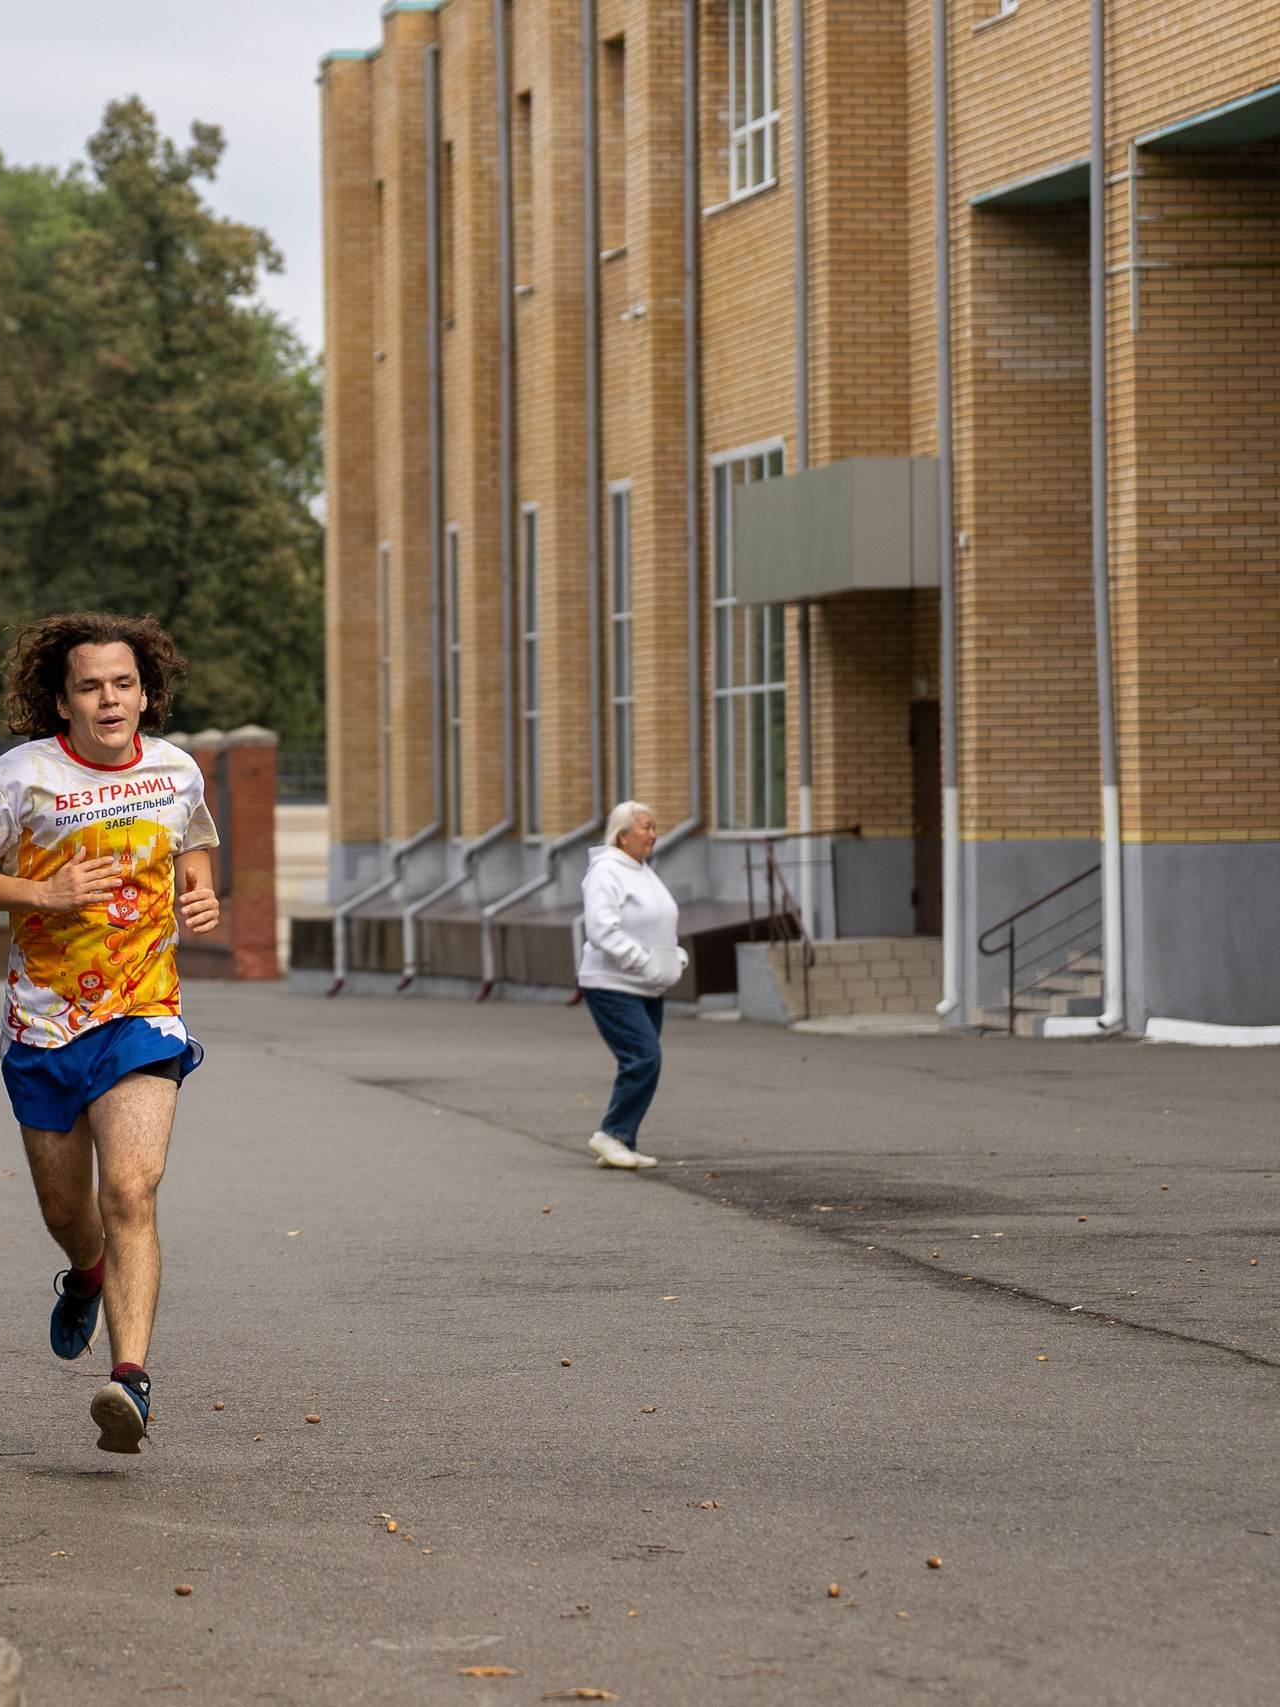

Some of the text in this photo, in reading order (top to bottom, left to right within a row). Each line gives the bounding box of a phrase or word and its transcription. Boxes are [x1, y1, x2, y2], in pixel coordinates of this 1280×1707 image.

[55, 776, 176, 811] БЕЗ ГРАНИЦ
[55, 794, 175, 826] БЛАГОТВОРИТЕЛЬНЫЙ
[105, 815, 138, 830] ЗАБЕГ
